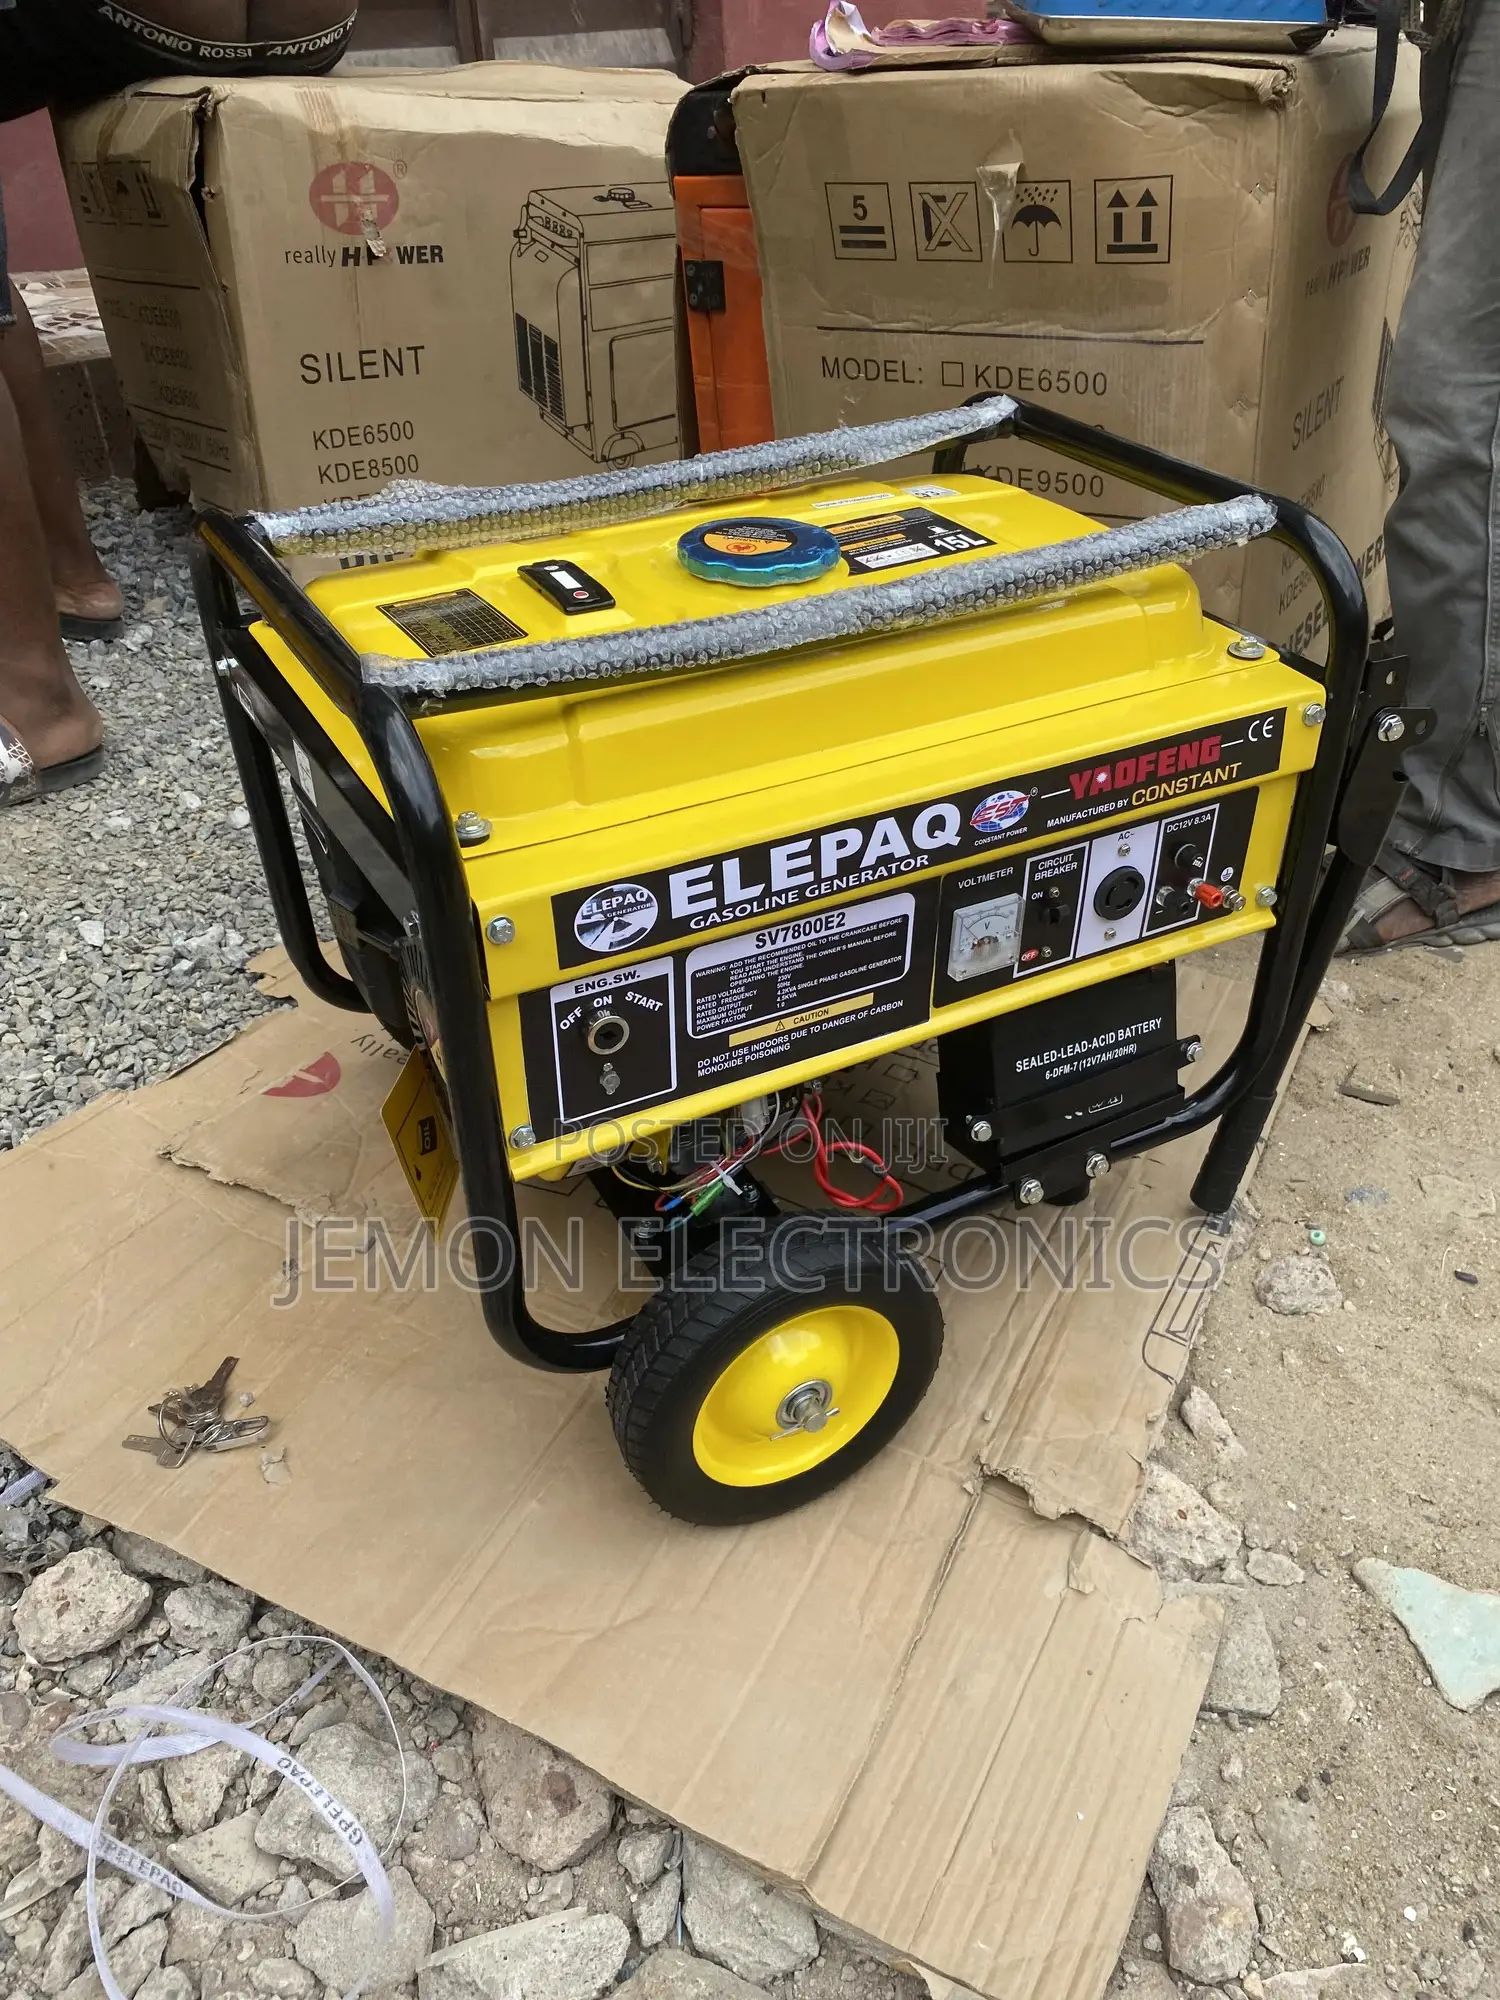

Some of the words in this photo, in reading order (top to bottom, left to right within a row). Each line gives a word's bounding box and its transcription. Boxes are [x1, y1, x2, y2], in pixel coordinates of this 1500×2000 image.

[98, 5, 193, 52] ANTONIO
[199, 46, 252, 58] ROSSI
[267, 28, 343, 56] ANTONIO
[285, 245, 336, 267] really
[299, 345, 426, 385] SILENT
[821, 356, 924, 384] MODEL:
[975, 366, 1108, 397] KDE6500
[1292, 376, 1345, 451] SILENT
[313, 420, 415, 451] KDE6500
[317, 454, 419, 485] KDE8500
[983, 465, 1104, 498] DE9500
[934, 533, 988, 552] 15L
[1069, 735, 1223, 800] YAOFENG
[1046, 802, 1116, 828] MANUFACTURED
[1117, 798, 1130, 810] BY
[1131, 762, 1243, 806] CONSTANT
[974, 832, 1006, 847] CONSTANT
[1006, 826, 1028, 838] POWER
[1166, 819, 1193, 833] DC12V
[1194, 813, 1212, 826] 8.3A
[668, 802, 962, 919] ELEPAQ
[1034, 862, 1078, 881] BREAKER
[1038, 853, 1075, 871] CIRCUIT
[689, 884, 800, 930] GASOLINE
[805, 854, 930, 897] GENERATOR
[958, 866, 1014, 889] VOLTMETER
[582, 889, 649, 916] ELEPAQ
[1031, 891, 1044, 900] ON
[729, 961, 743, 969] ADD
[744, 957, 757, 965] THE
[757, 944, 806, 961] RECOMMENDED
[807, 941, 818, 949] OIL
[828, 934, 841, 942] THE
[840, 925, 878, 939] CRANKCASE
[878, 917, 903, 929] BEFORE
[755, 911, 846, 949] SV7800E2
[729, 972, 748, 981] READ
[748, 968, 762, 977] AND
[762, 957, 805, 973] UNDERSTAND
[805, 953, 818, 961] THE
[847, 939, 873, 949] MANUAL
[873, 931, 897, 942] BEFORE
[730, 968, 744, 976] YOU
[744, 962, 765, 972] START
[766, 959, 779, 967] THE
[1021, 950, 1038, 962] OFF
[574, 970, 641, 995] ENG.SW.
[696, 1009, 717, 1019] RATED
[717, 1001, 742, 1013] OUTPUT
[797, 979, 818, 990] SINGLE
[818, 973, 839, 984] PHASE
[839, 964, 868, 978] GASOLINE
[868, 955, 903, 969] GENERATOR
[696, 994, 717, 1005] RATED
[717, 986, 746, 999] VOLTAGE
[777, 973, 792, 982] 230V
[729, 972, 766, 988] OPERATING
[767, 969, 779, 977] THE
[593, 994, 613, 1008] ON
[625, 991, 664, 1012] START
[696, 1002, 717, 1012] RATED
[720, 989, 758, 1005] FREQUENCY
[776, 981, 791, 989] 50Hz
[559, 1006, 584, 1031] OFF
[696, 1012, 727, 1026] MAXIMUM
[727, 1004, 753, 1017] OUTPUT
[696, 1021, 721, 1032] POWER
[721, 1012, 747, 1025] FACTOR
[793, 1008, 829, 1025] CAUTION
[349, 1034, 410, 1065] eally
[697, 1058, 711, 1069] DO
[712, 1051, 731, 1064] NOT
[732, 1046, 749, 1058] USE
[751, 1035, 789, 1052] INDOORS
[790, 1028, 808, 1040] DUE
[809, 1024, 821, 1035] TO
[822, 1014, 856, 1031] DANGER
[857, 1009, 868, 1020] OF
[869, 1000, 904, 1018] CARBON
[1015, 1032, 1117, 1073] SEALED-LEAD-ACID
[1117, 1017, 1162, 1041] BATTERY
[697, 1057, 743, 1078] MONOXIDE
[744, 1042, 791, 1063] POISONING
